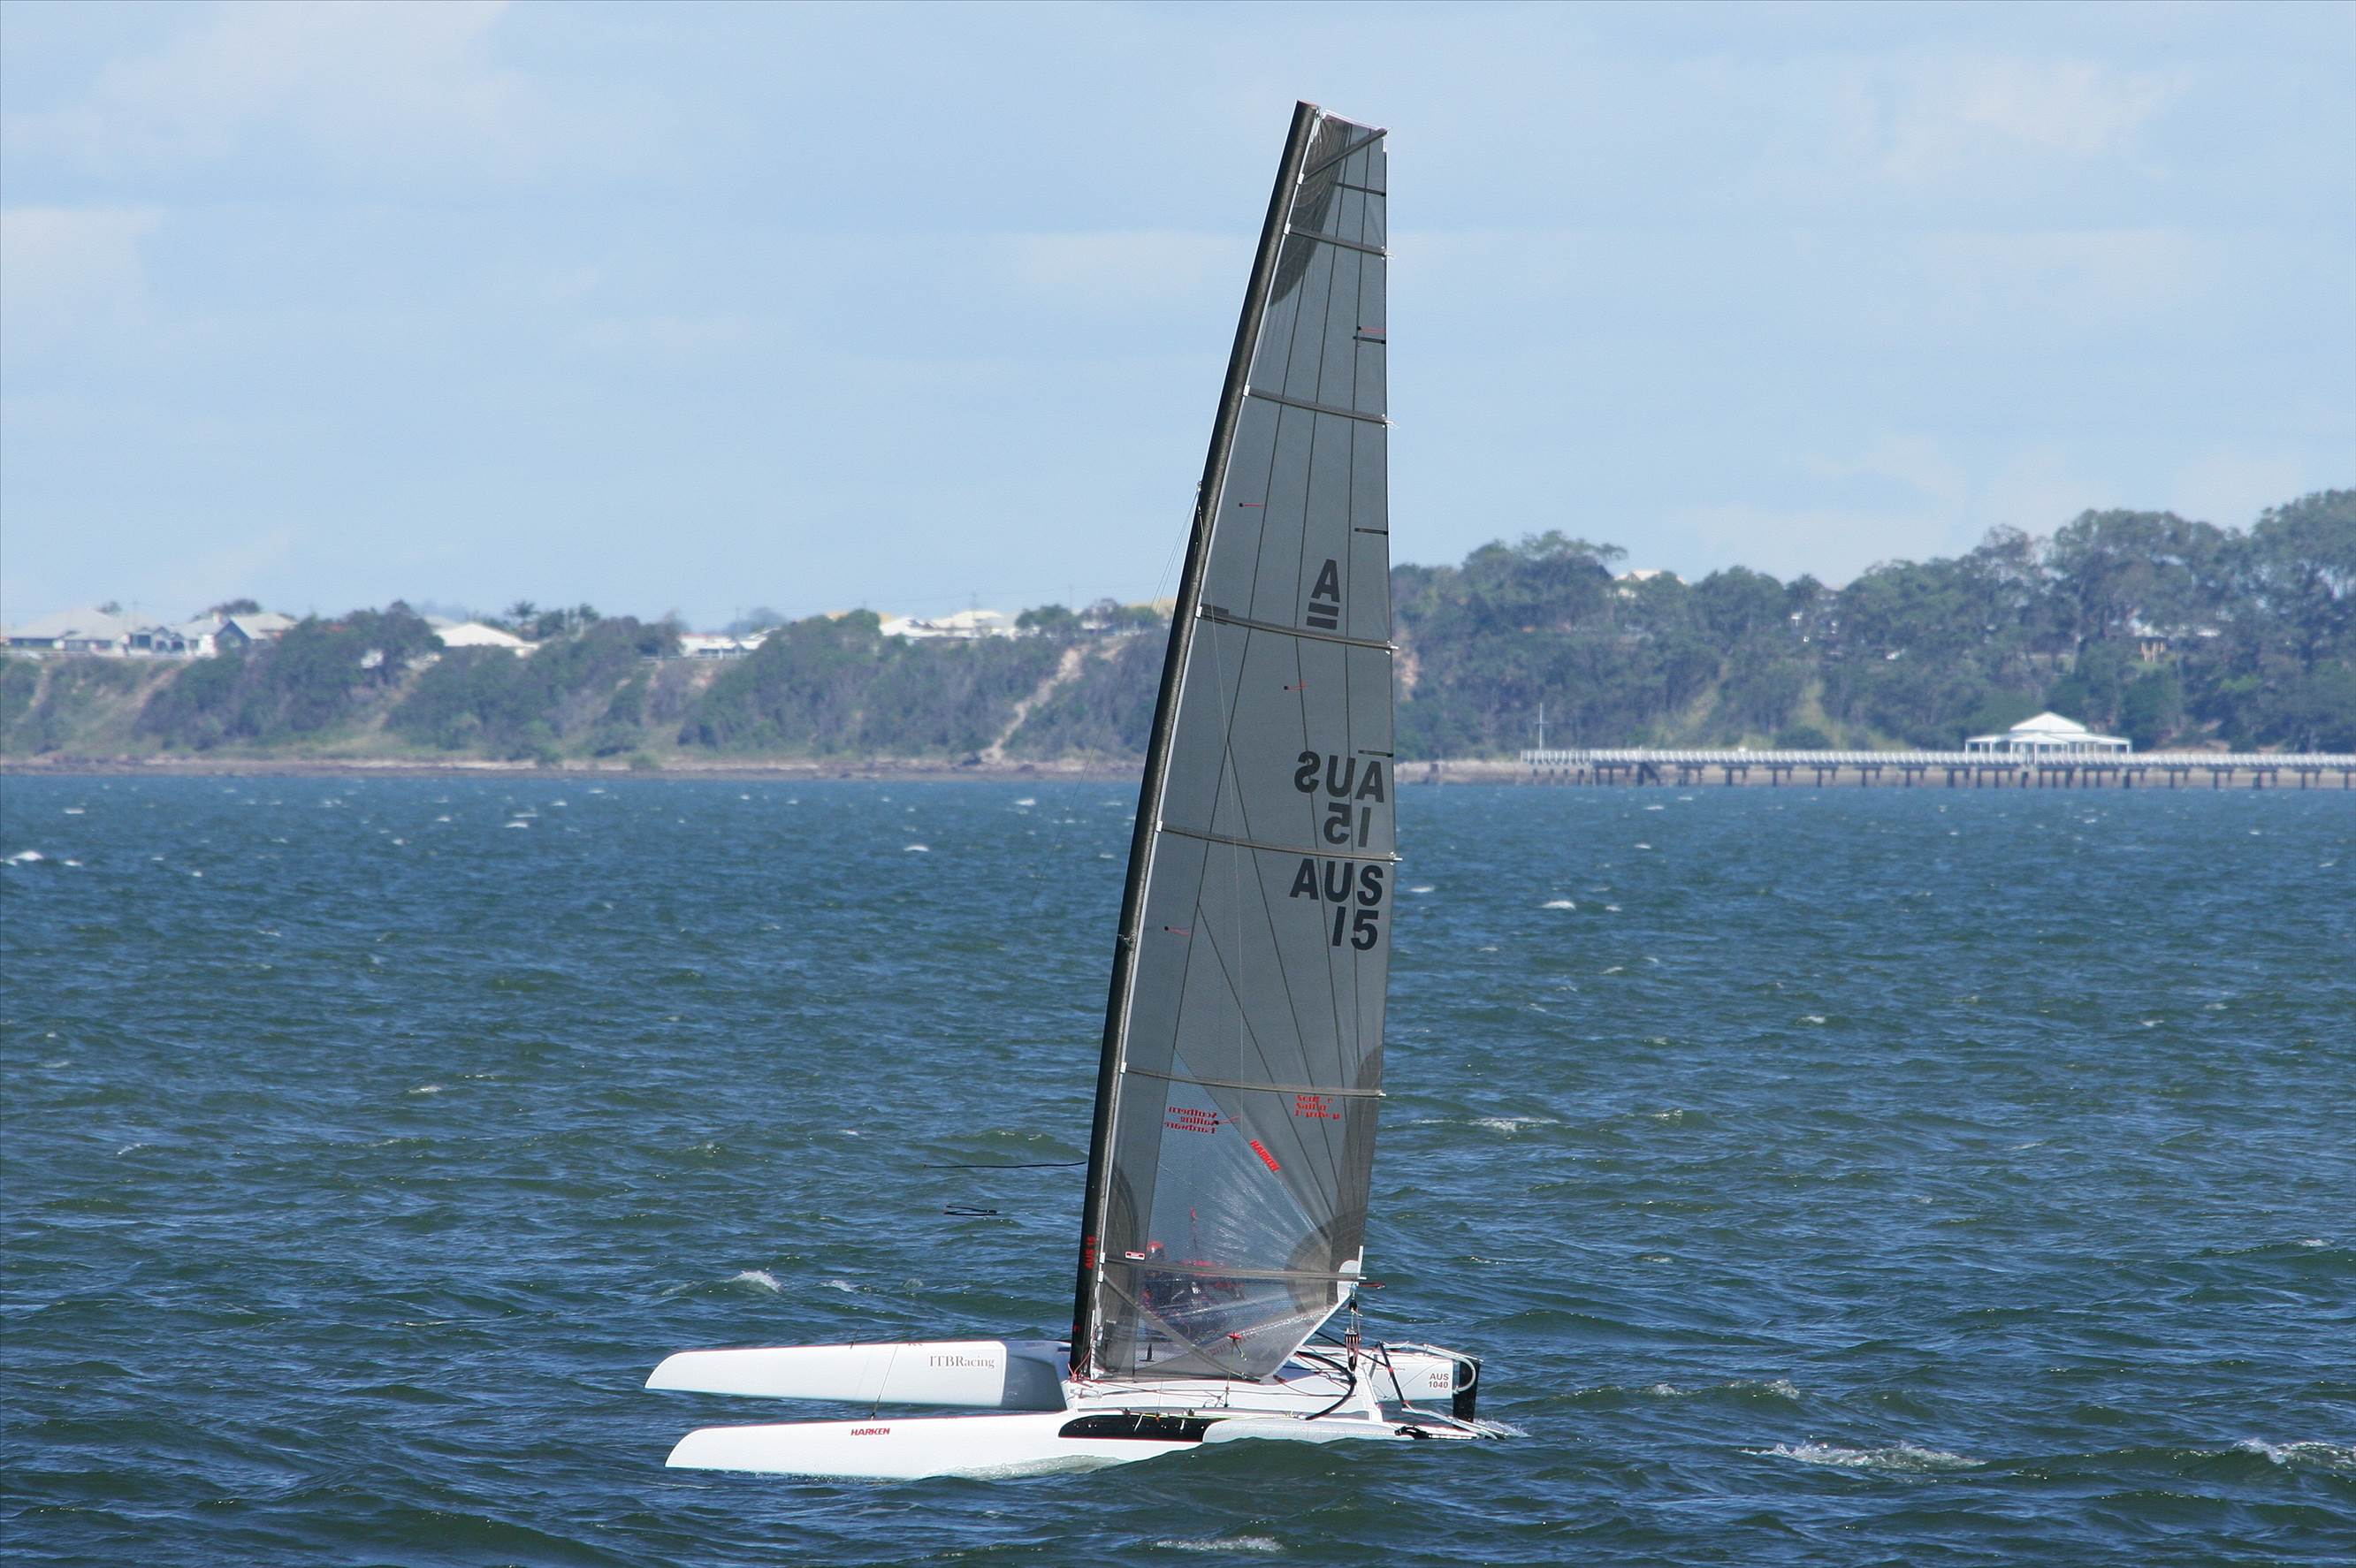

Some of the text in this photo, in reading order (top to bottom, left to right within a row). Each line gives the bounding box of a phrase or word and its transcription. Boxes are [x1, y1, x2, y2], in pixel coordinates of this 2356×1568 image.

[1311, 559, 1340, 603] A
[1290, 858, 1384, 907] AUS
[1332, 906, 1379, 951] 15
[930, 1355, 995, 1369] ITBRacing
[850, 1427, 890, 1436] HARKEN
